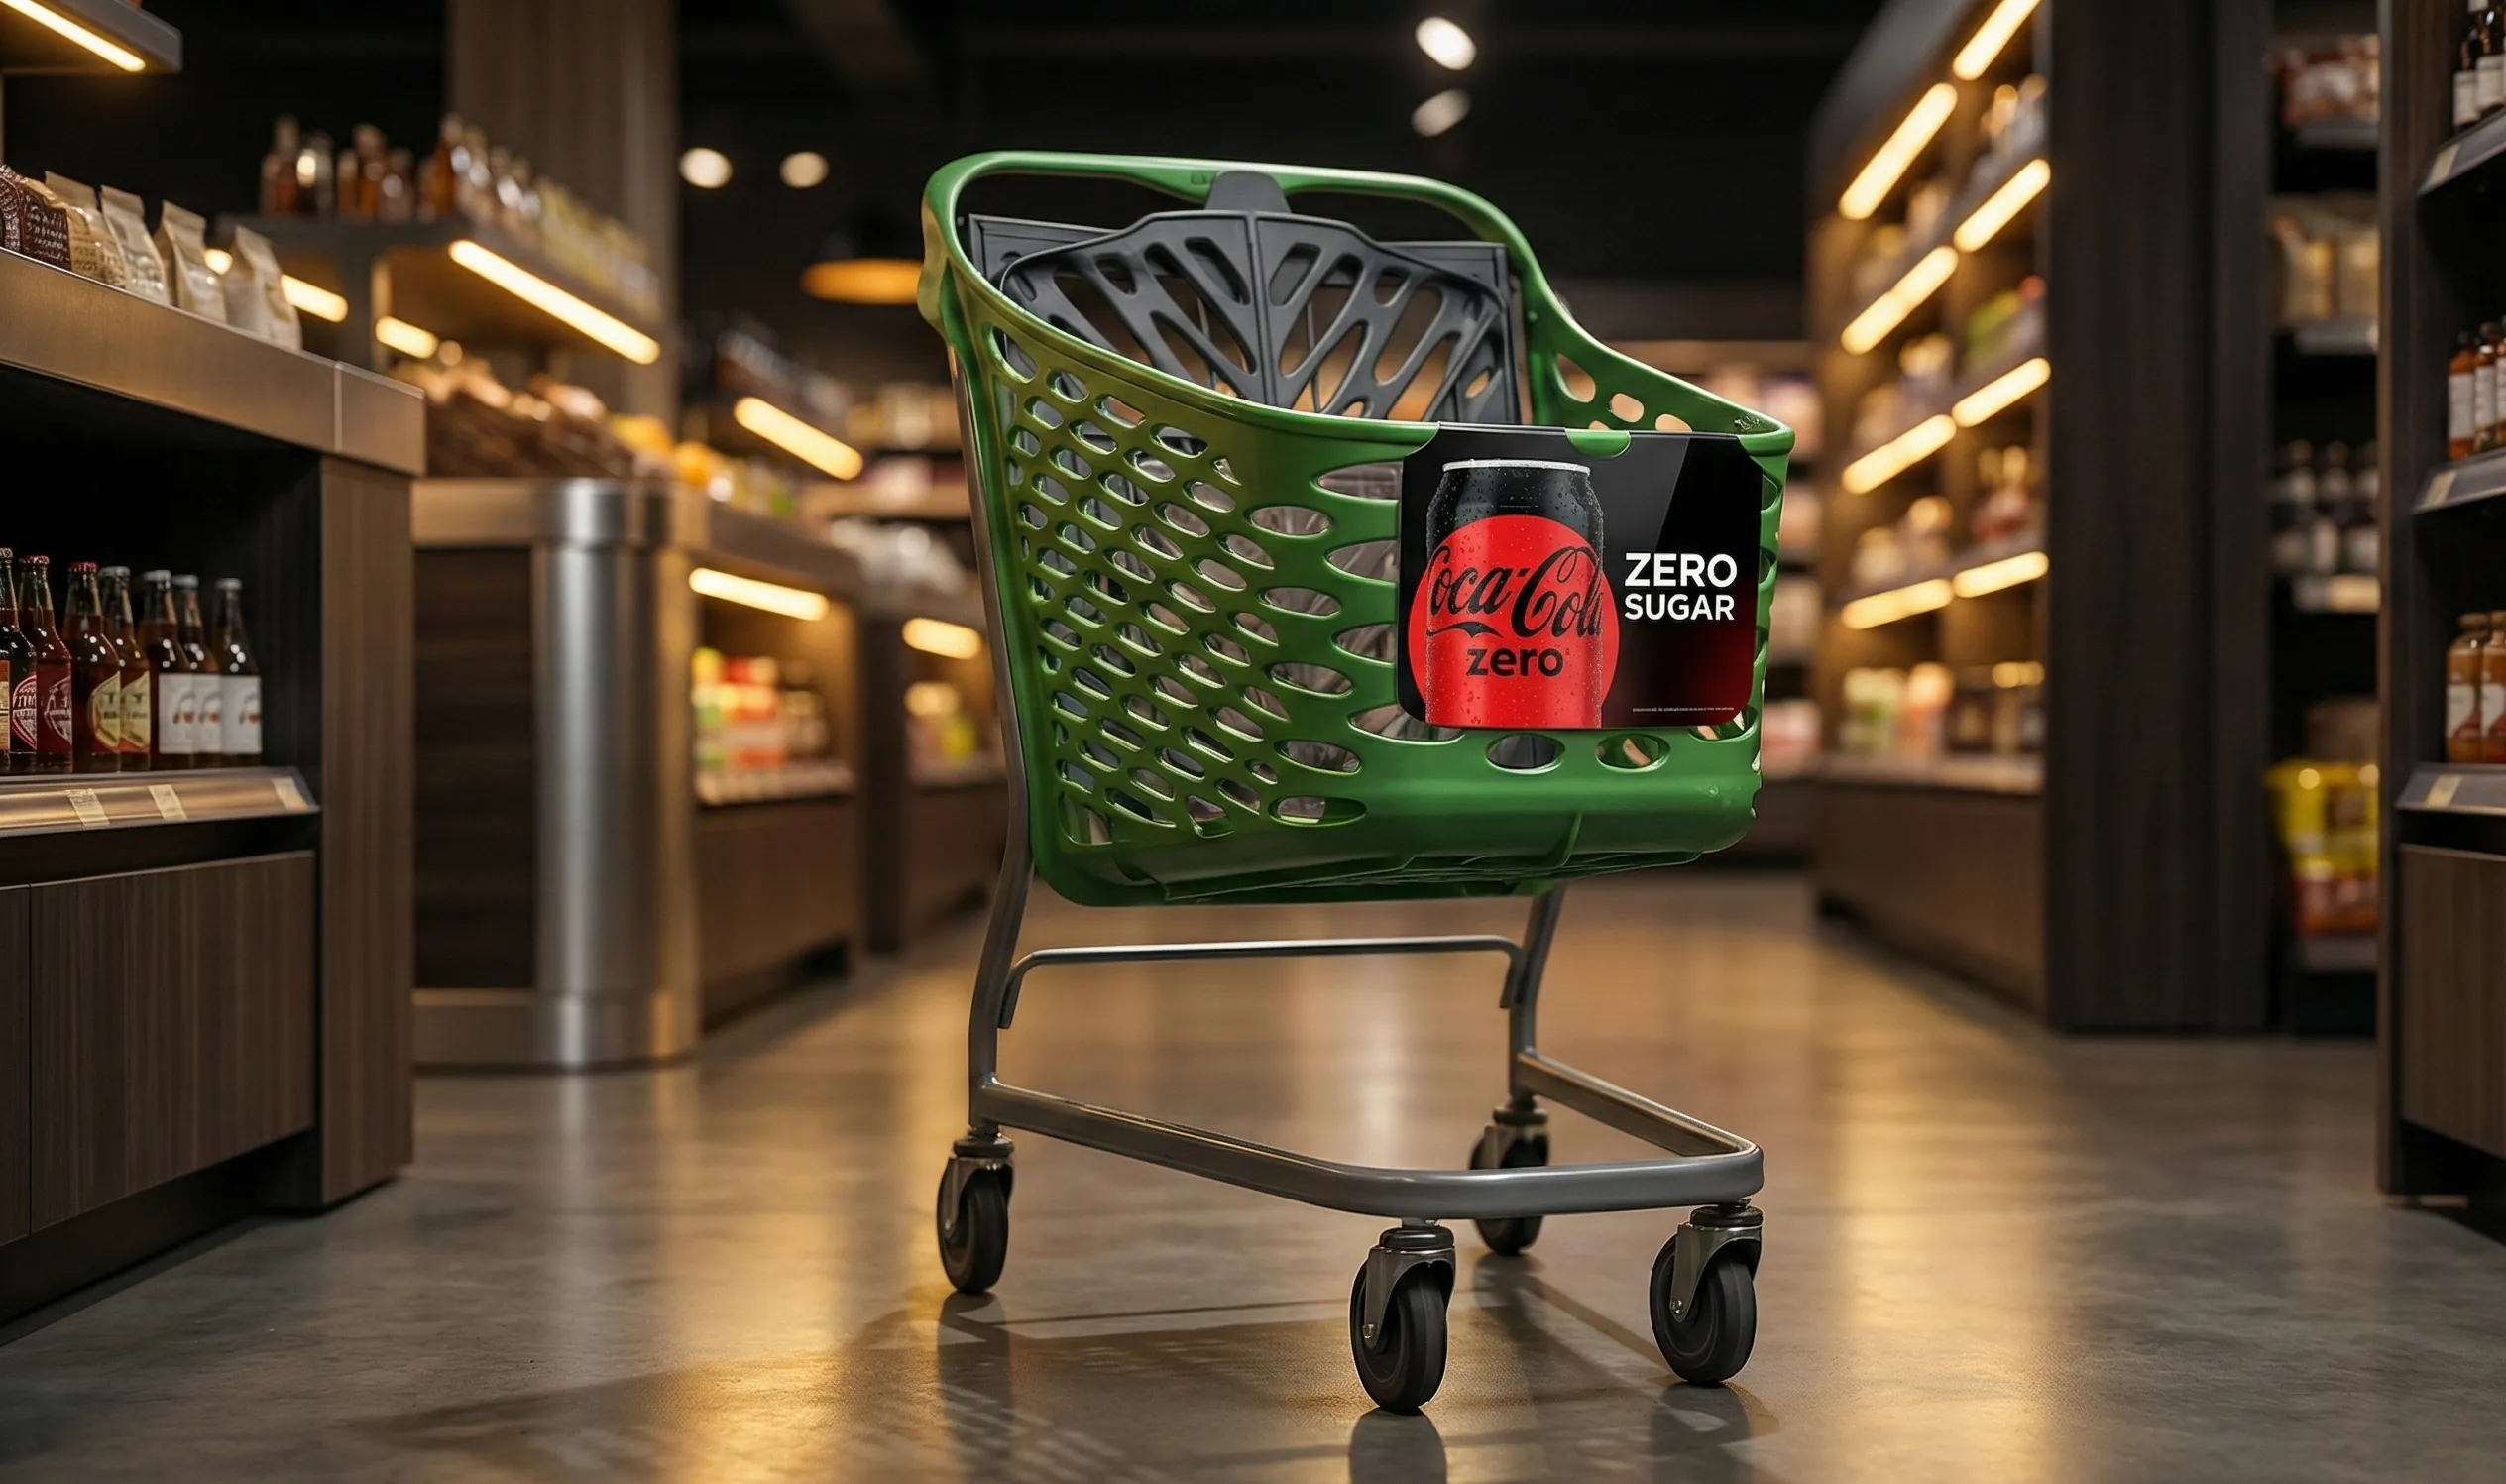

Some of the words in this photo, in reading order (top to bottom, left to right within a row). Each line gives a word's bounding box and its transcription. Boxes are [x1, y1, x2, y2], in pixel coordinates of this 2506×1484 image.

[1624, 552, 1738, 588] ZERO
[1624, 592, 1736, 621] SUGAR
[1465, 647, 1564, 677] zero
